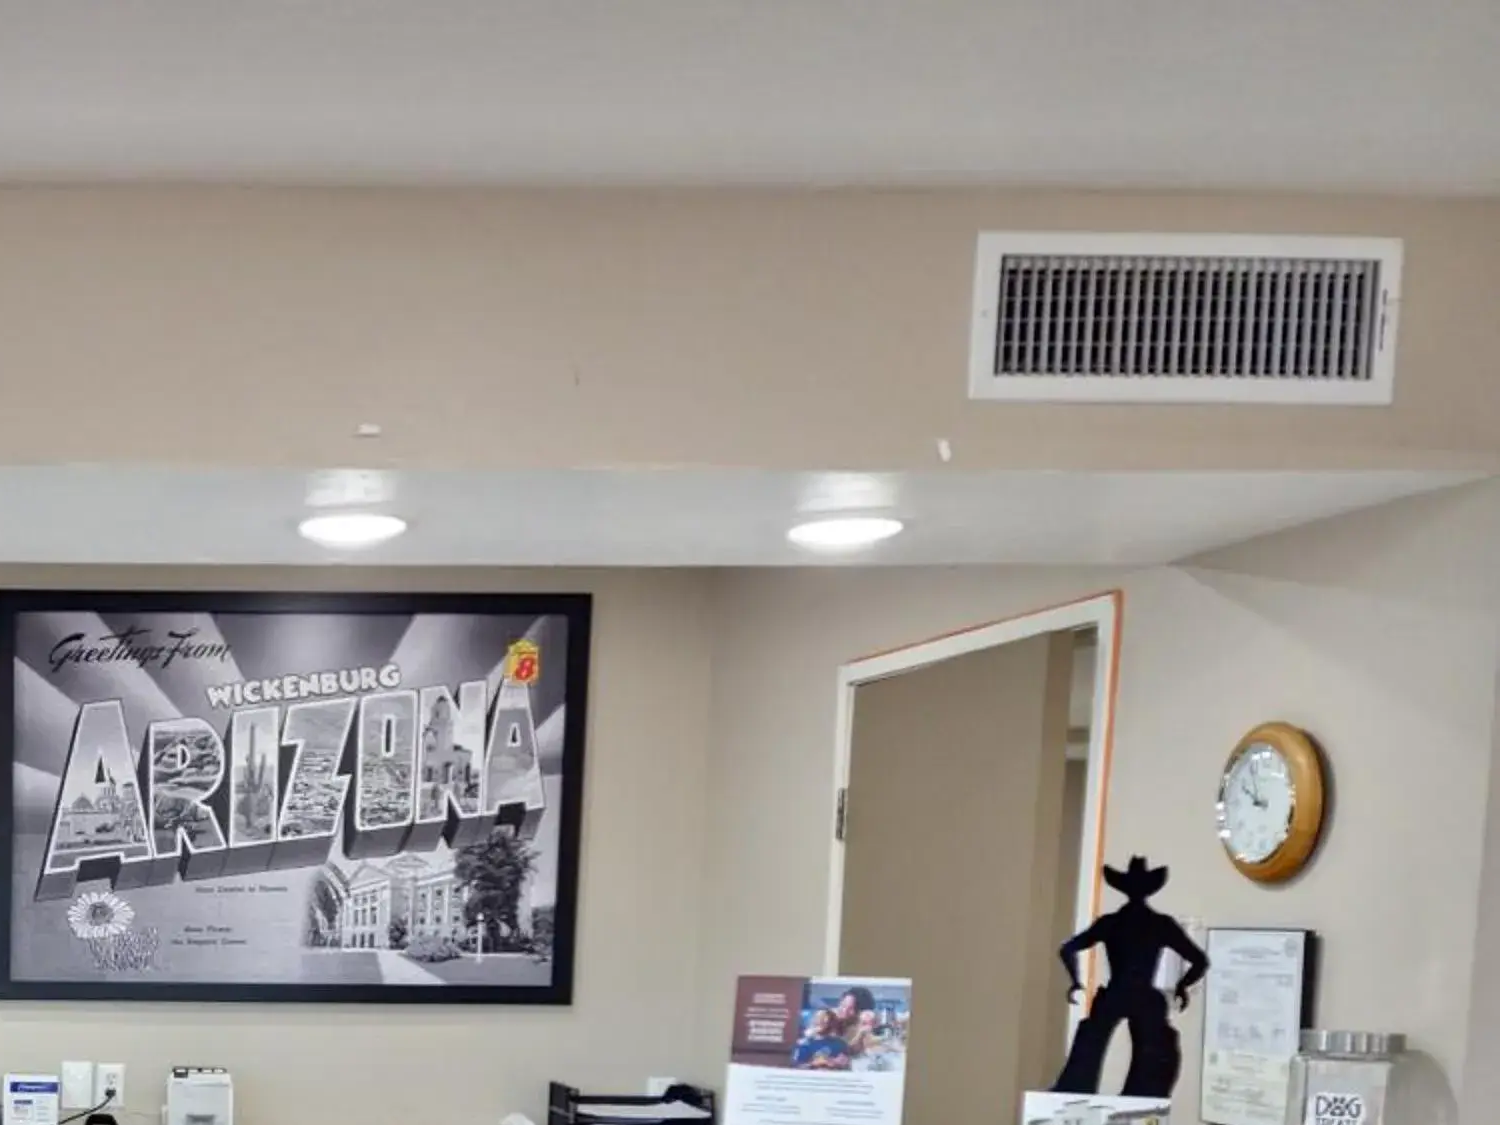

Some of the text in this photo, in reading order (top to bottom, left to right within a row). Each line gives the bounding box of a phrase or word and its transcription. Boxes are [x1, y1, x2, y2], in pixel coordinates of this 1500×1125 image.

[48, 625, 232, 673] Greetings From
[206, 663, 402, 709] WICKENBURG
[38, 676, 545, 894] ARIZONA
